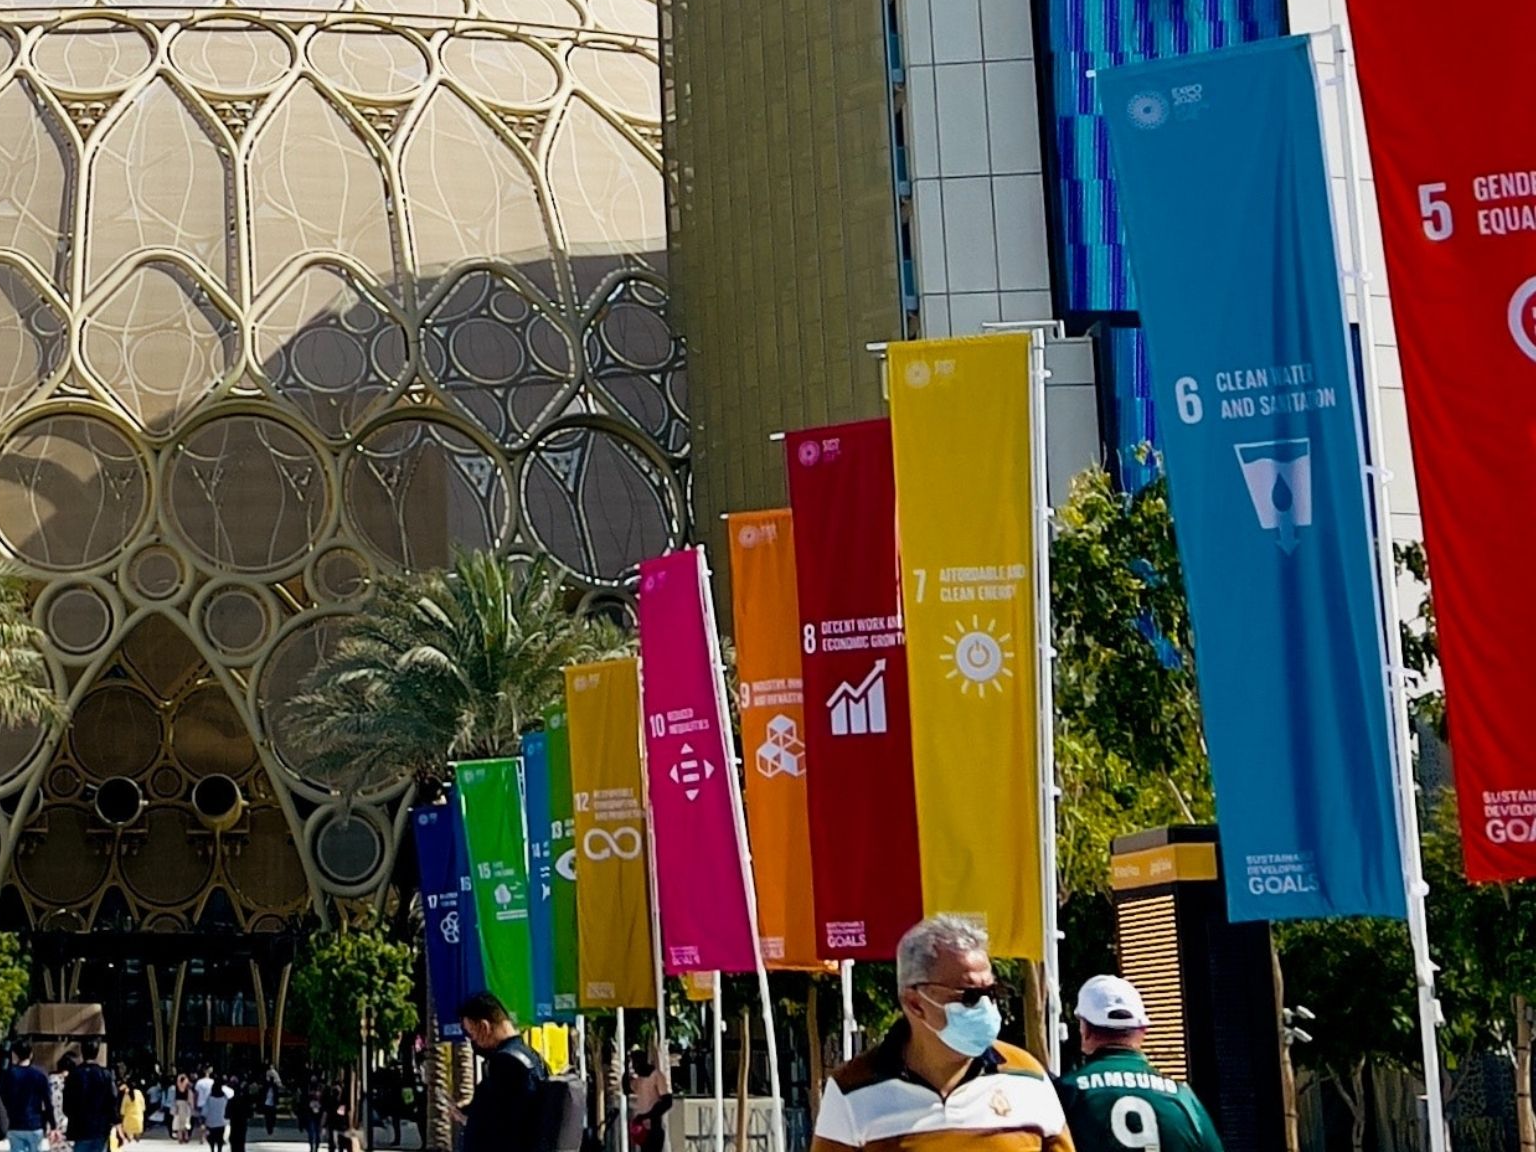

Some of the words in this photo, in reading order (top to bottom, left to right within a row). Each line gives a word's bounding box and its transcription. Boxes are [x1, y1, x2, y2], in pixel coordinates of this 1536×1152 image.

[1473, 171, 1536, 202] GENDE
[1417, 181, 1453, 241] 5
[1477, 205, 1536, 235] EQUA
[1216, 368, 1268, 393] CLEAN
[1175, 376, 1203, 425] 6
[1221, 398, 1255, 420] AND
[912, 568, 927, 604] 7
[939, 586, 976, 603] CLEAN
[821, 618, 855, 635] DECENT
[856, 616, 885, 632] WORK
[803, 623, 816, 654] 8
[822, 636, 869, 652] ECONOMIC
[739, 682, 750, 708] 9
[649, 713, 666, 738] 10
[575, 791, 589, 812] 12
[1482, 790, 1536, 804] SUSTAI
[1484, 804, 1536, 818] DEVELO
[1486, 818, 1536, 843] GO
[1248, 874, 1319, 895] GOALS
[827, 933, 867, 948] GOALS
[1076, 1071, 1178, 1094] SAMSUNG
[1111, 1095, 1160, 1152] 9
